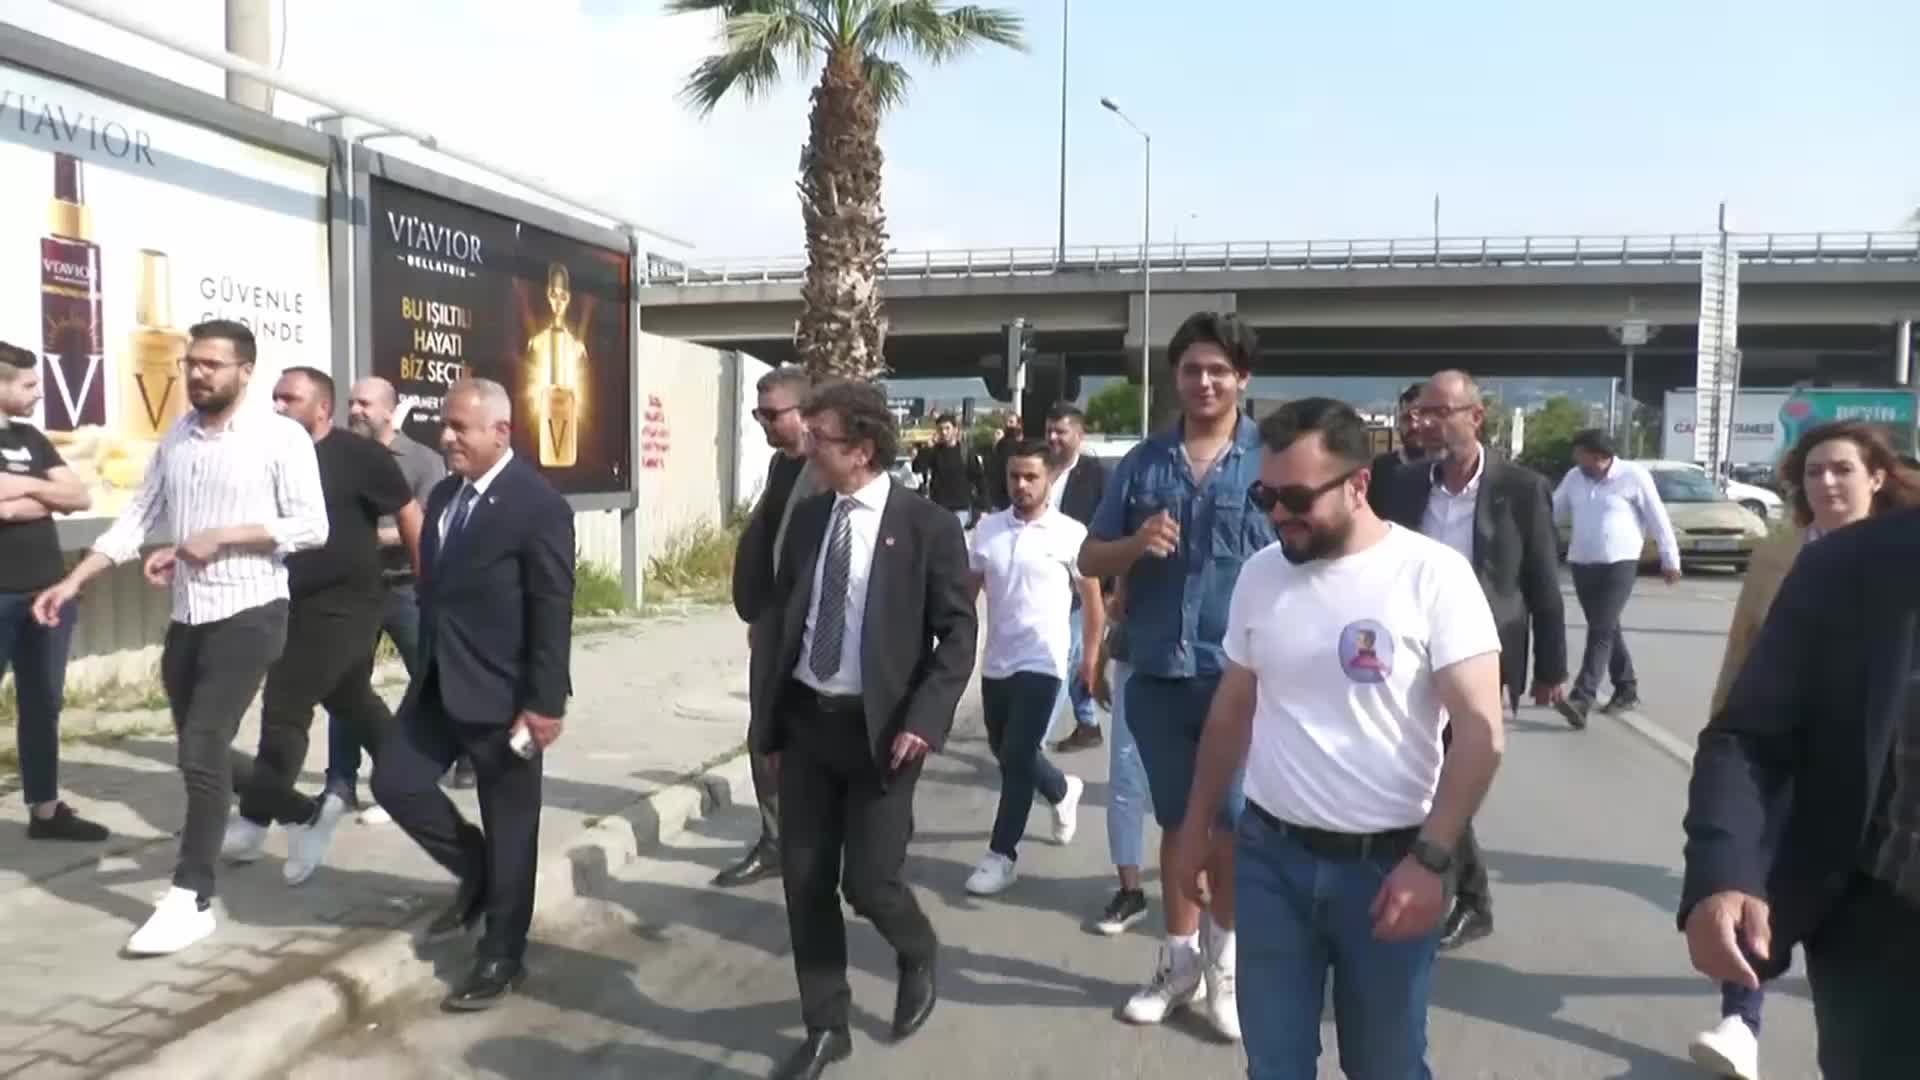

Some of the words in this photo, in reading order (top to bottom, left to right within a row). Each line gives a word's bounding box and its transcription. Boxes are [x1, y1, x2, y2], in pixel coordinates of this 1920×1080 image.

[199, 274, 303, 314] GÜVENLE
[402, 296, 423, 321] BU
[414, 328, 463, 357] HAYATI
[400, 354, 425, 381] BİZ
[43, 353, 103, 427] V
[133, 373, 177, 432] V
